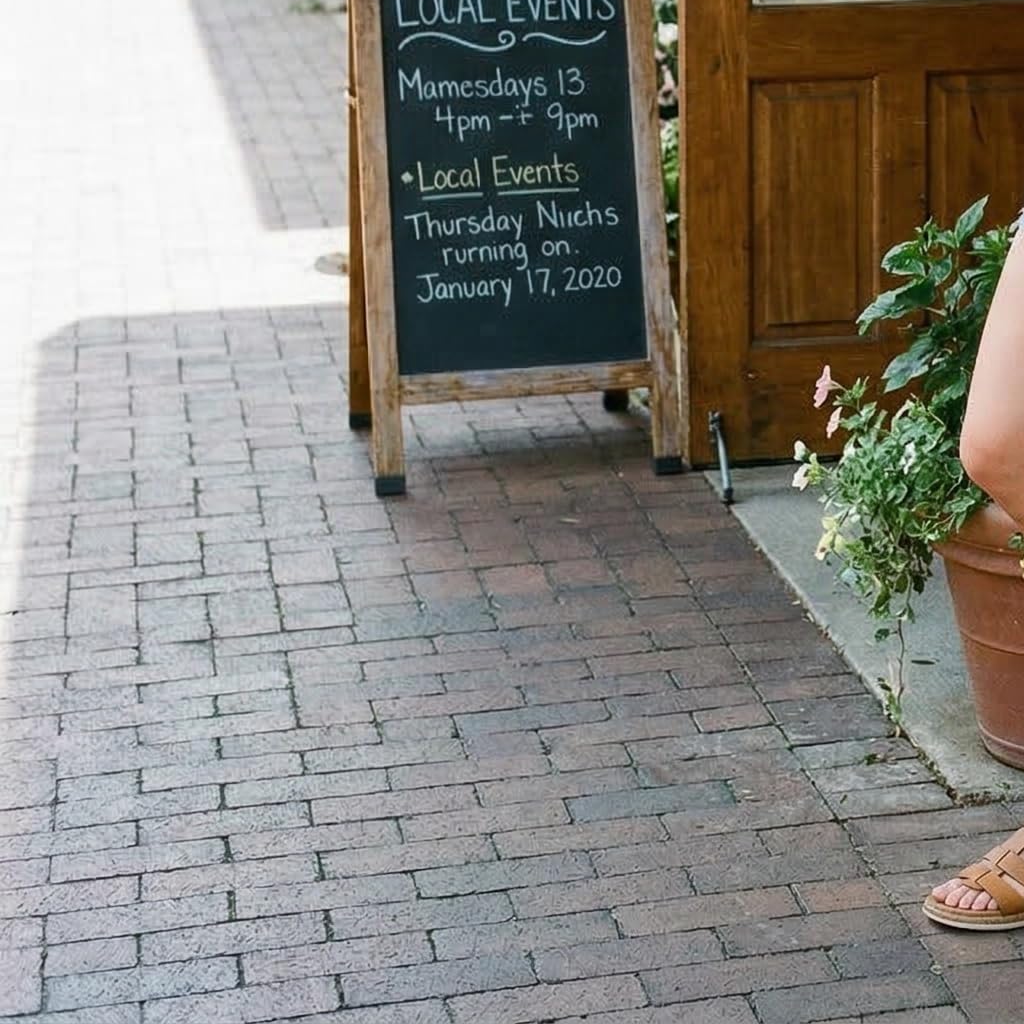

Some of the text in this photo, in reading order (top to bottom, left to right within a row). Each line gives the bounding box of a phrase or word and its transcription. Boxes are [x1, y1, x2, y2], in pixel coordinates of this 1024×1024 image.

[398, 66, 585, 107] Mamesdays 13
[435, 105, 491, 142] 4pm
[546, 102, 599, 140] 9pm
[417, 152, 580, 193] Local Events
[404, 205, 523, 241] Thursday
[416, 273, 512, 308] January
